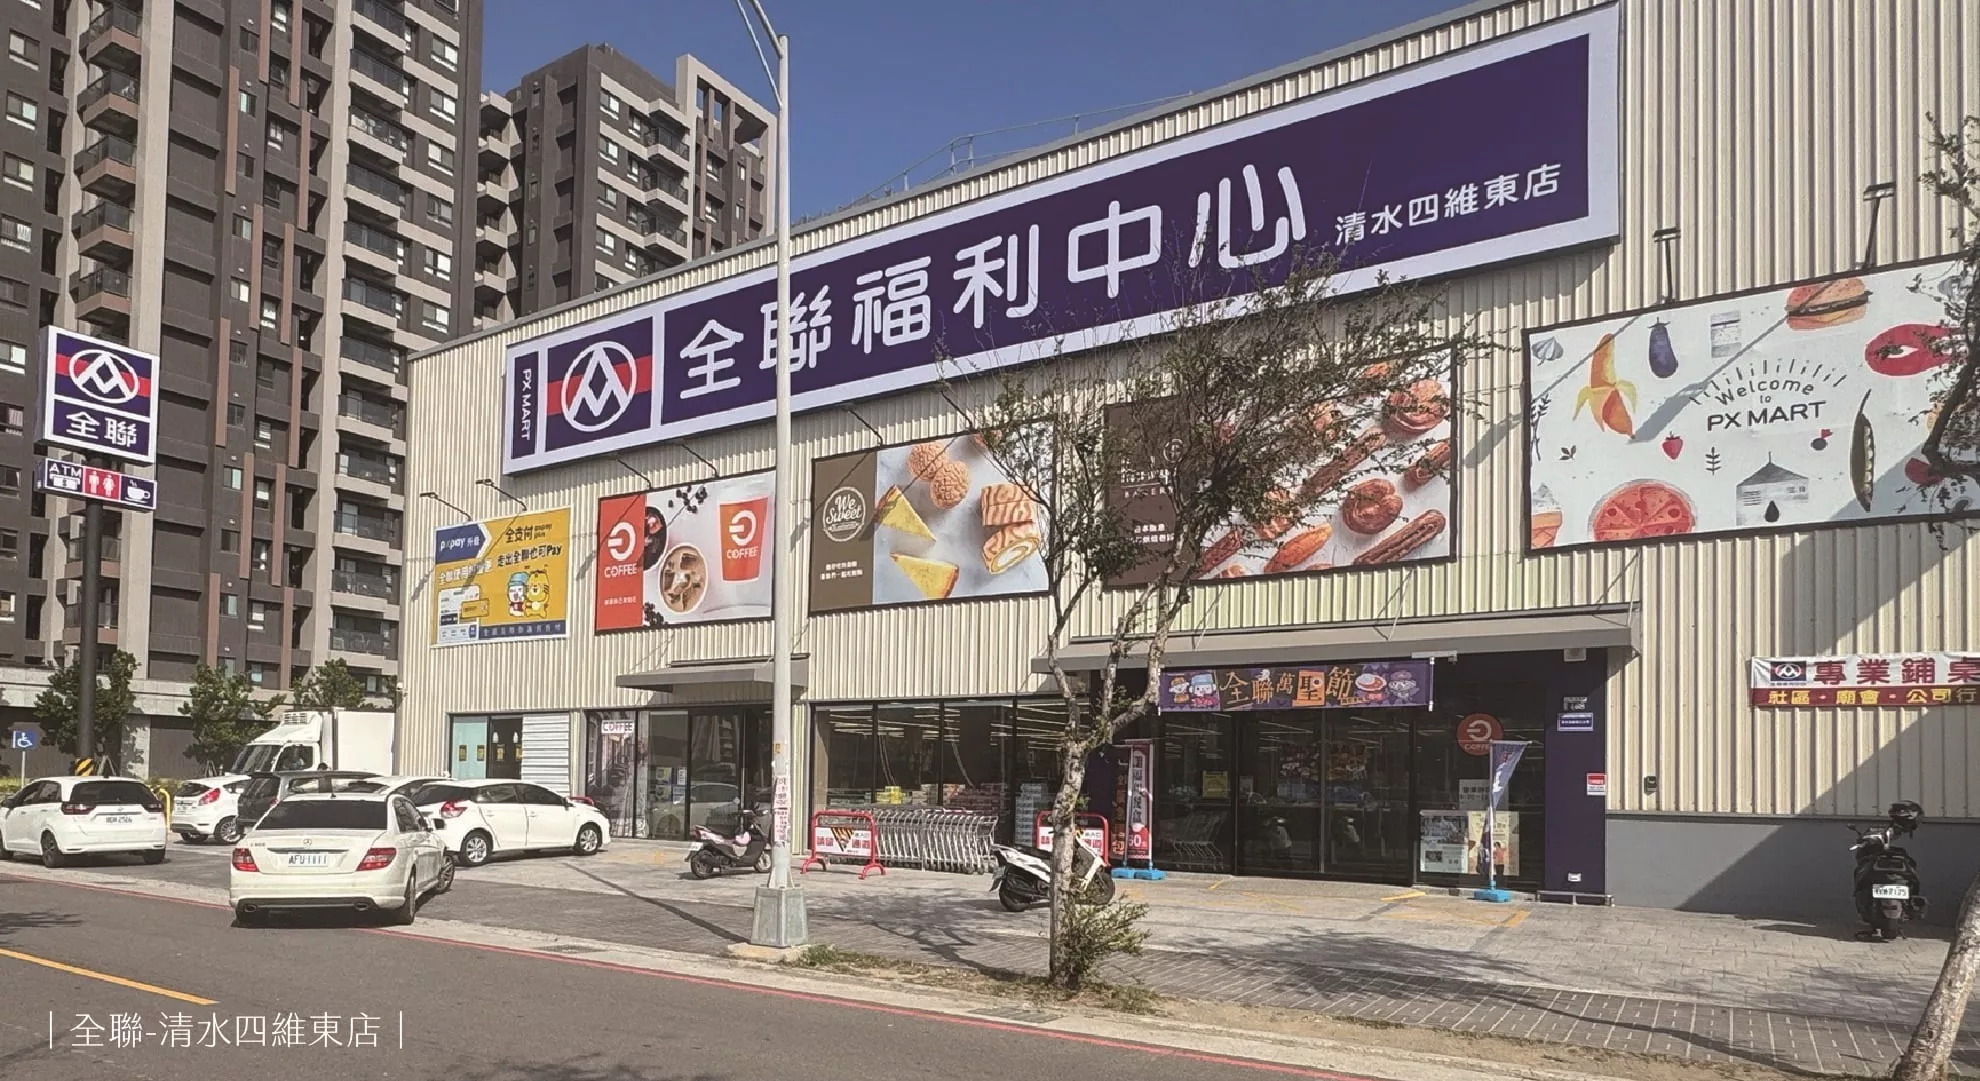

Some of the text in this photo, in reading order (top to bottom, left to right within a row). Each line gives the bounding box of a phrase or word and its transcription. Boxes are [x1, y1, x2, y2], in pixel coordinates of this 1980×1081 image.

[680, 162, 1562, 400] 全聯福利中心 清水四維東店
[521, 368, 532, 441] PX MART
[1715, 379, 1815, 406] Welcome
[1760, 394, 1772, 404] to
[66, 411, 137, 447] 全聯
[1707, 400, 1827, 432] PX MART
[49, 463, 82, 479] ATM
[826, 505, 863, 525] Sweet
[835, 493, 857, 521] We
[727, 546, 759, 559] COFFEE
[604, 563, 637, 578] COFFEE
